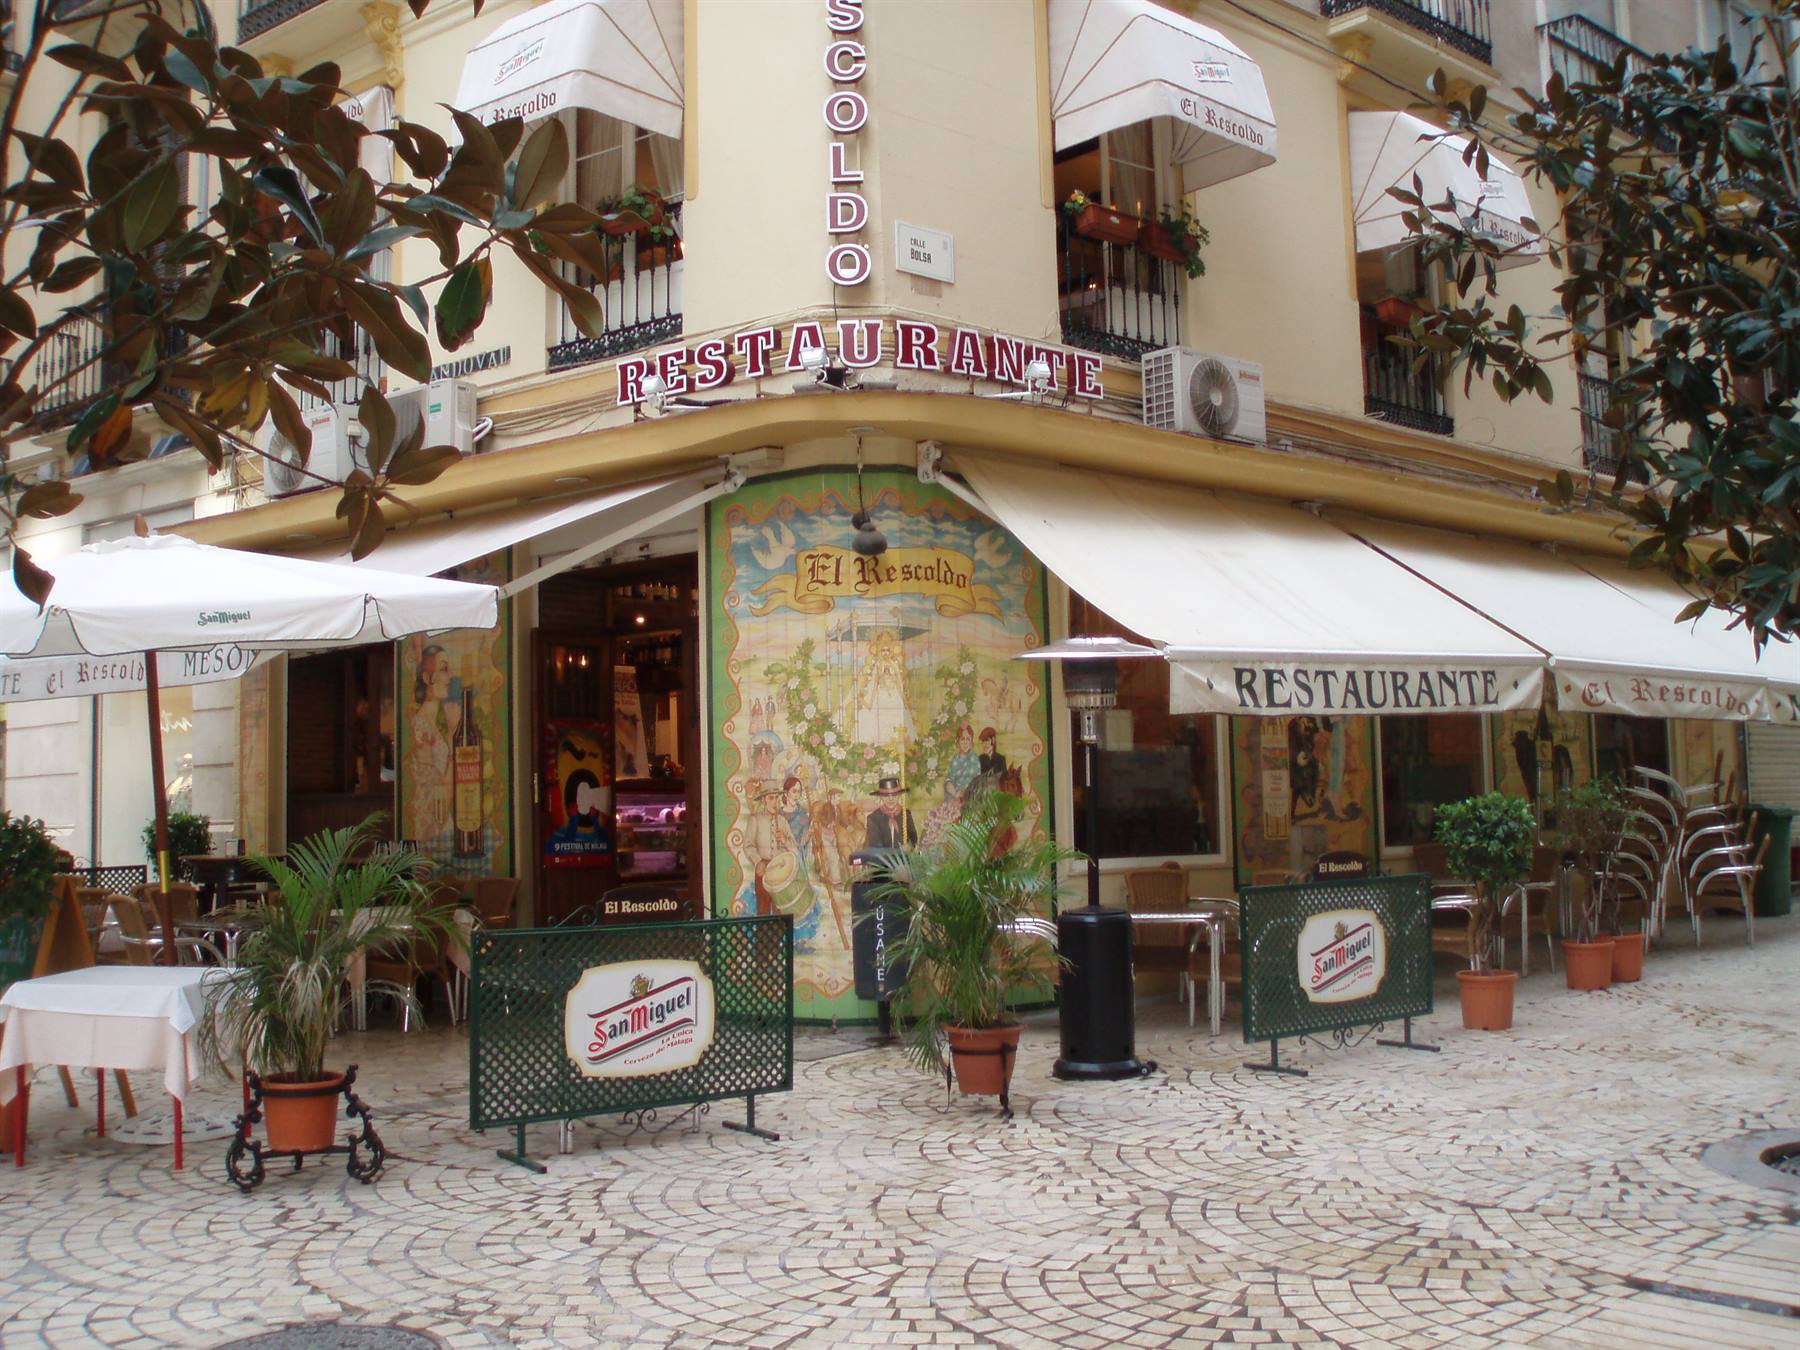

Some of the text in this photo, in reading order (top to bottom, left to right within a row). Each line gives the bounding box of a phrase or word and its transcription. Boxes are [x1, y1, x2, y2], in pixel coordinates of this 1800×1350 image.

[1181, 98, 1264, 146] El Rescoldo
[910, 238, 926, 249] CALLE
[910, 248, 932, 264] BOLSA
[430, 345, 508, 381] ANDOVAL
[616, 319, 1104, 407] RESTAURANTE
[803, 552, 968, 593] El Rescoldo
[46, 671, 64, 695] El
[77, 659, 146, 684] Rescold
[1233, 667, 1499, 709] RESTAURANTE
[1581, 680, 1617, 708] El
[1631, 677, 1750, 716] Rescoldo
[1319, 863, 1328, 873] El
[604, 899, 678, 914] El Rescoldo
